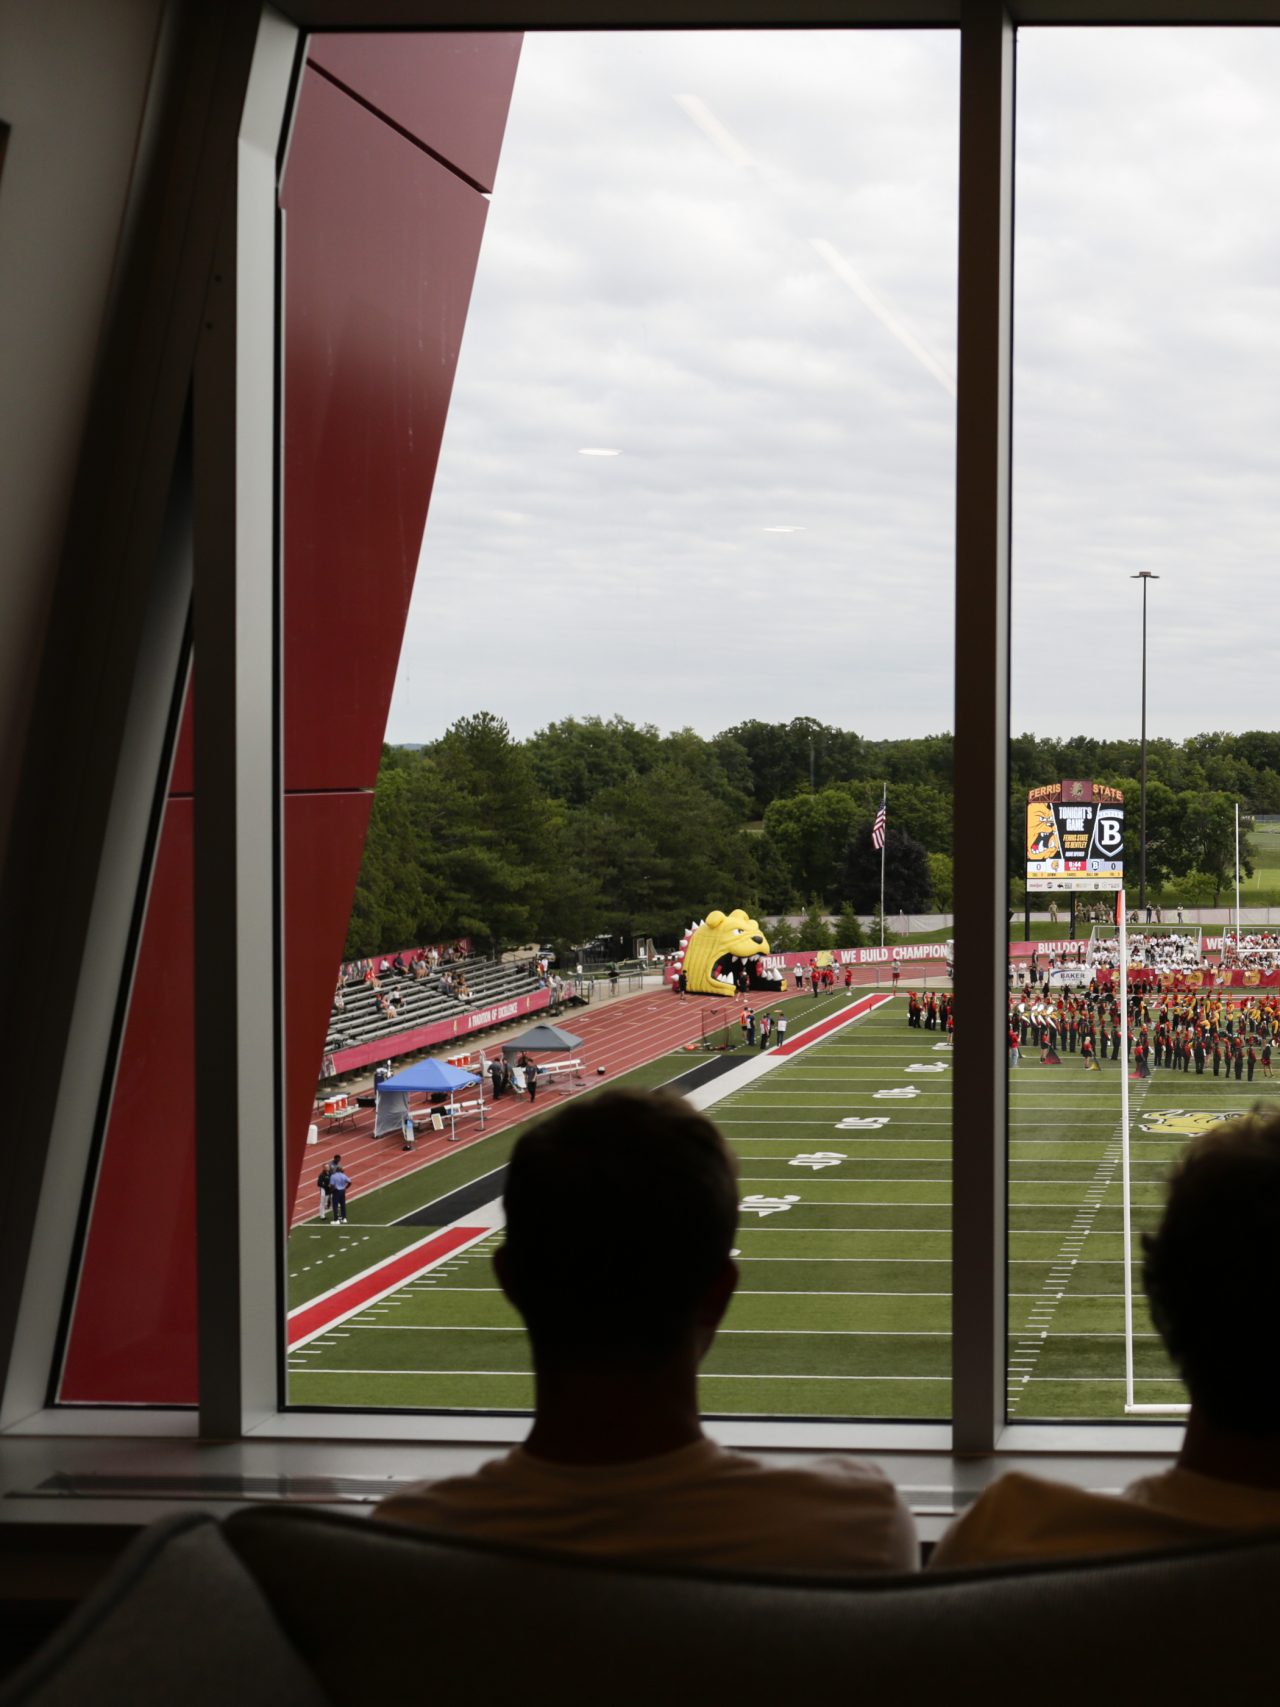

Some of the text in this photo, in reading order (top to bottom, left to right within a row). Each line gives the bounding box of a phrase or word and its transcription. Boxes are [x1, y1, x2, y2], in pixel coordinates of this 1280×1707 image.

[1029, 783, 1123, 800] FERRIS STATE
[1058, 806, 1092, 819] TONIGHT'S
[1066, 819, 1084, 831] GAME
[1100, 820, 1121, 845] B
[1111, 862, 1116, 870] 0
[1038, 941, 1085, 954] BULLDOG
[840, 945, 948, 964] WE BUILD CHAMPION
[491, 1008, 498, 1021] OF
[834, 1117, 891, 1129] 50
